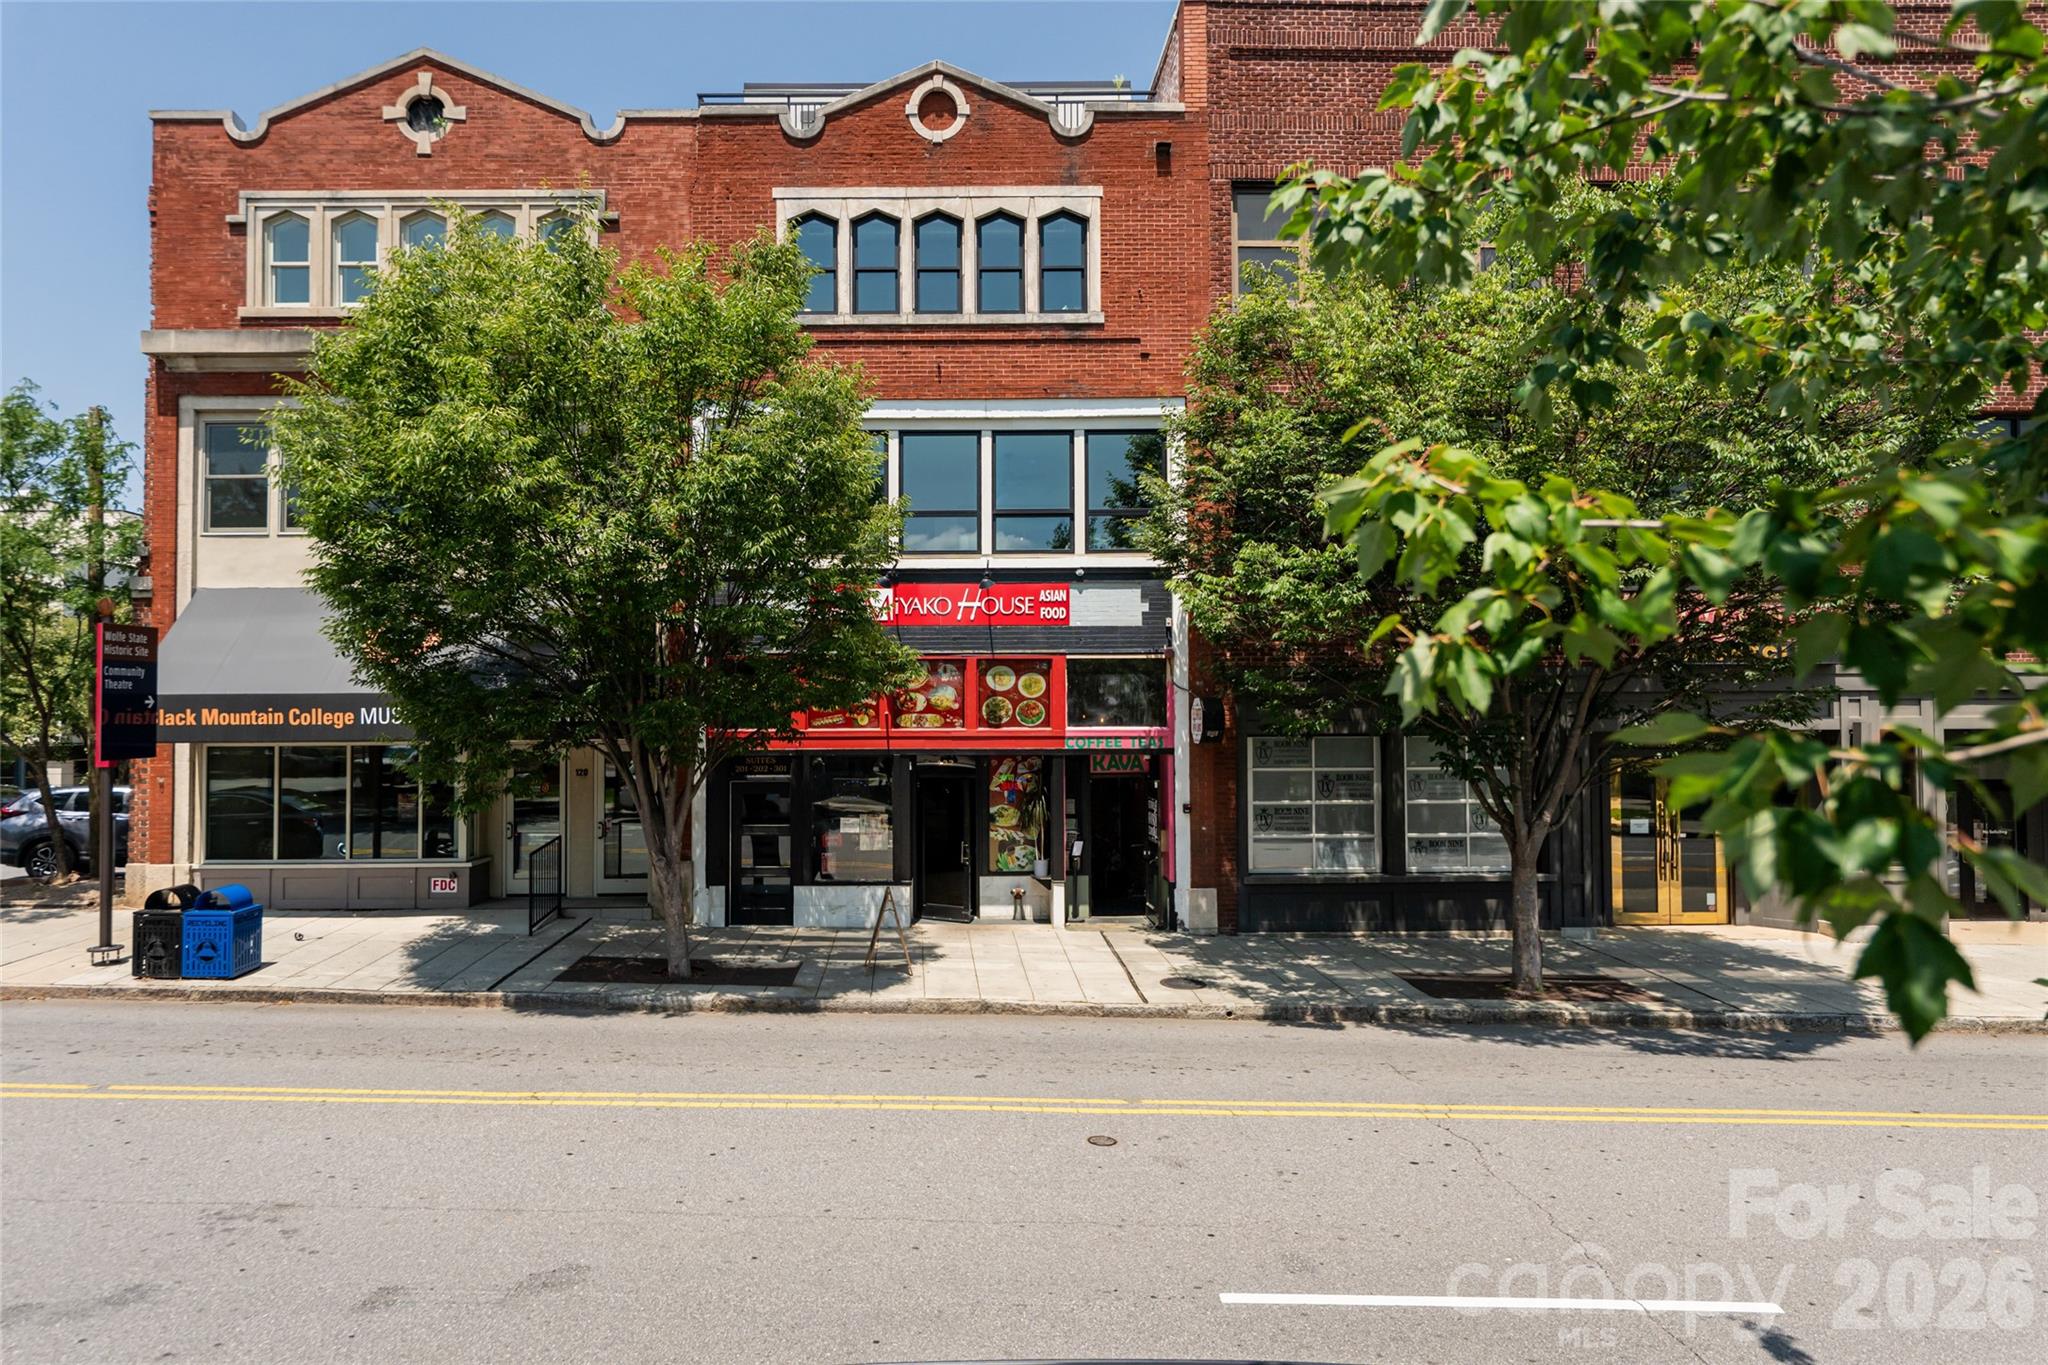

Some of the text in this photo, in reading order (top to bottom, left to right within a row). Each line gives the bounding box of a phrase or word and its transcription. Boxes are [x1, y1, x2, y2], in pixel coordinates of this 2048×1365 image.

[1039, 589, 1066, 602] ASIAN
[957, 588, 1034, 621] HOUSE
[1040, 607, 1066, 619] FOOD
[104, 632, 148, 643] Wolfe State
[104, 645, 149, 657] Historic Site
[104, 666, 145, 679] Community
[104, 679, 133, 690] Theatre
[156, 707, 412, 729] lack Mountain College MUS
[1066, 737, 1122, 750] COFFEE
[1092, 753, 1144, 769] KAVA
[432, 879, 456, 891] FDC
